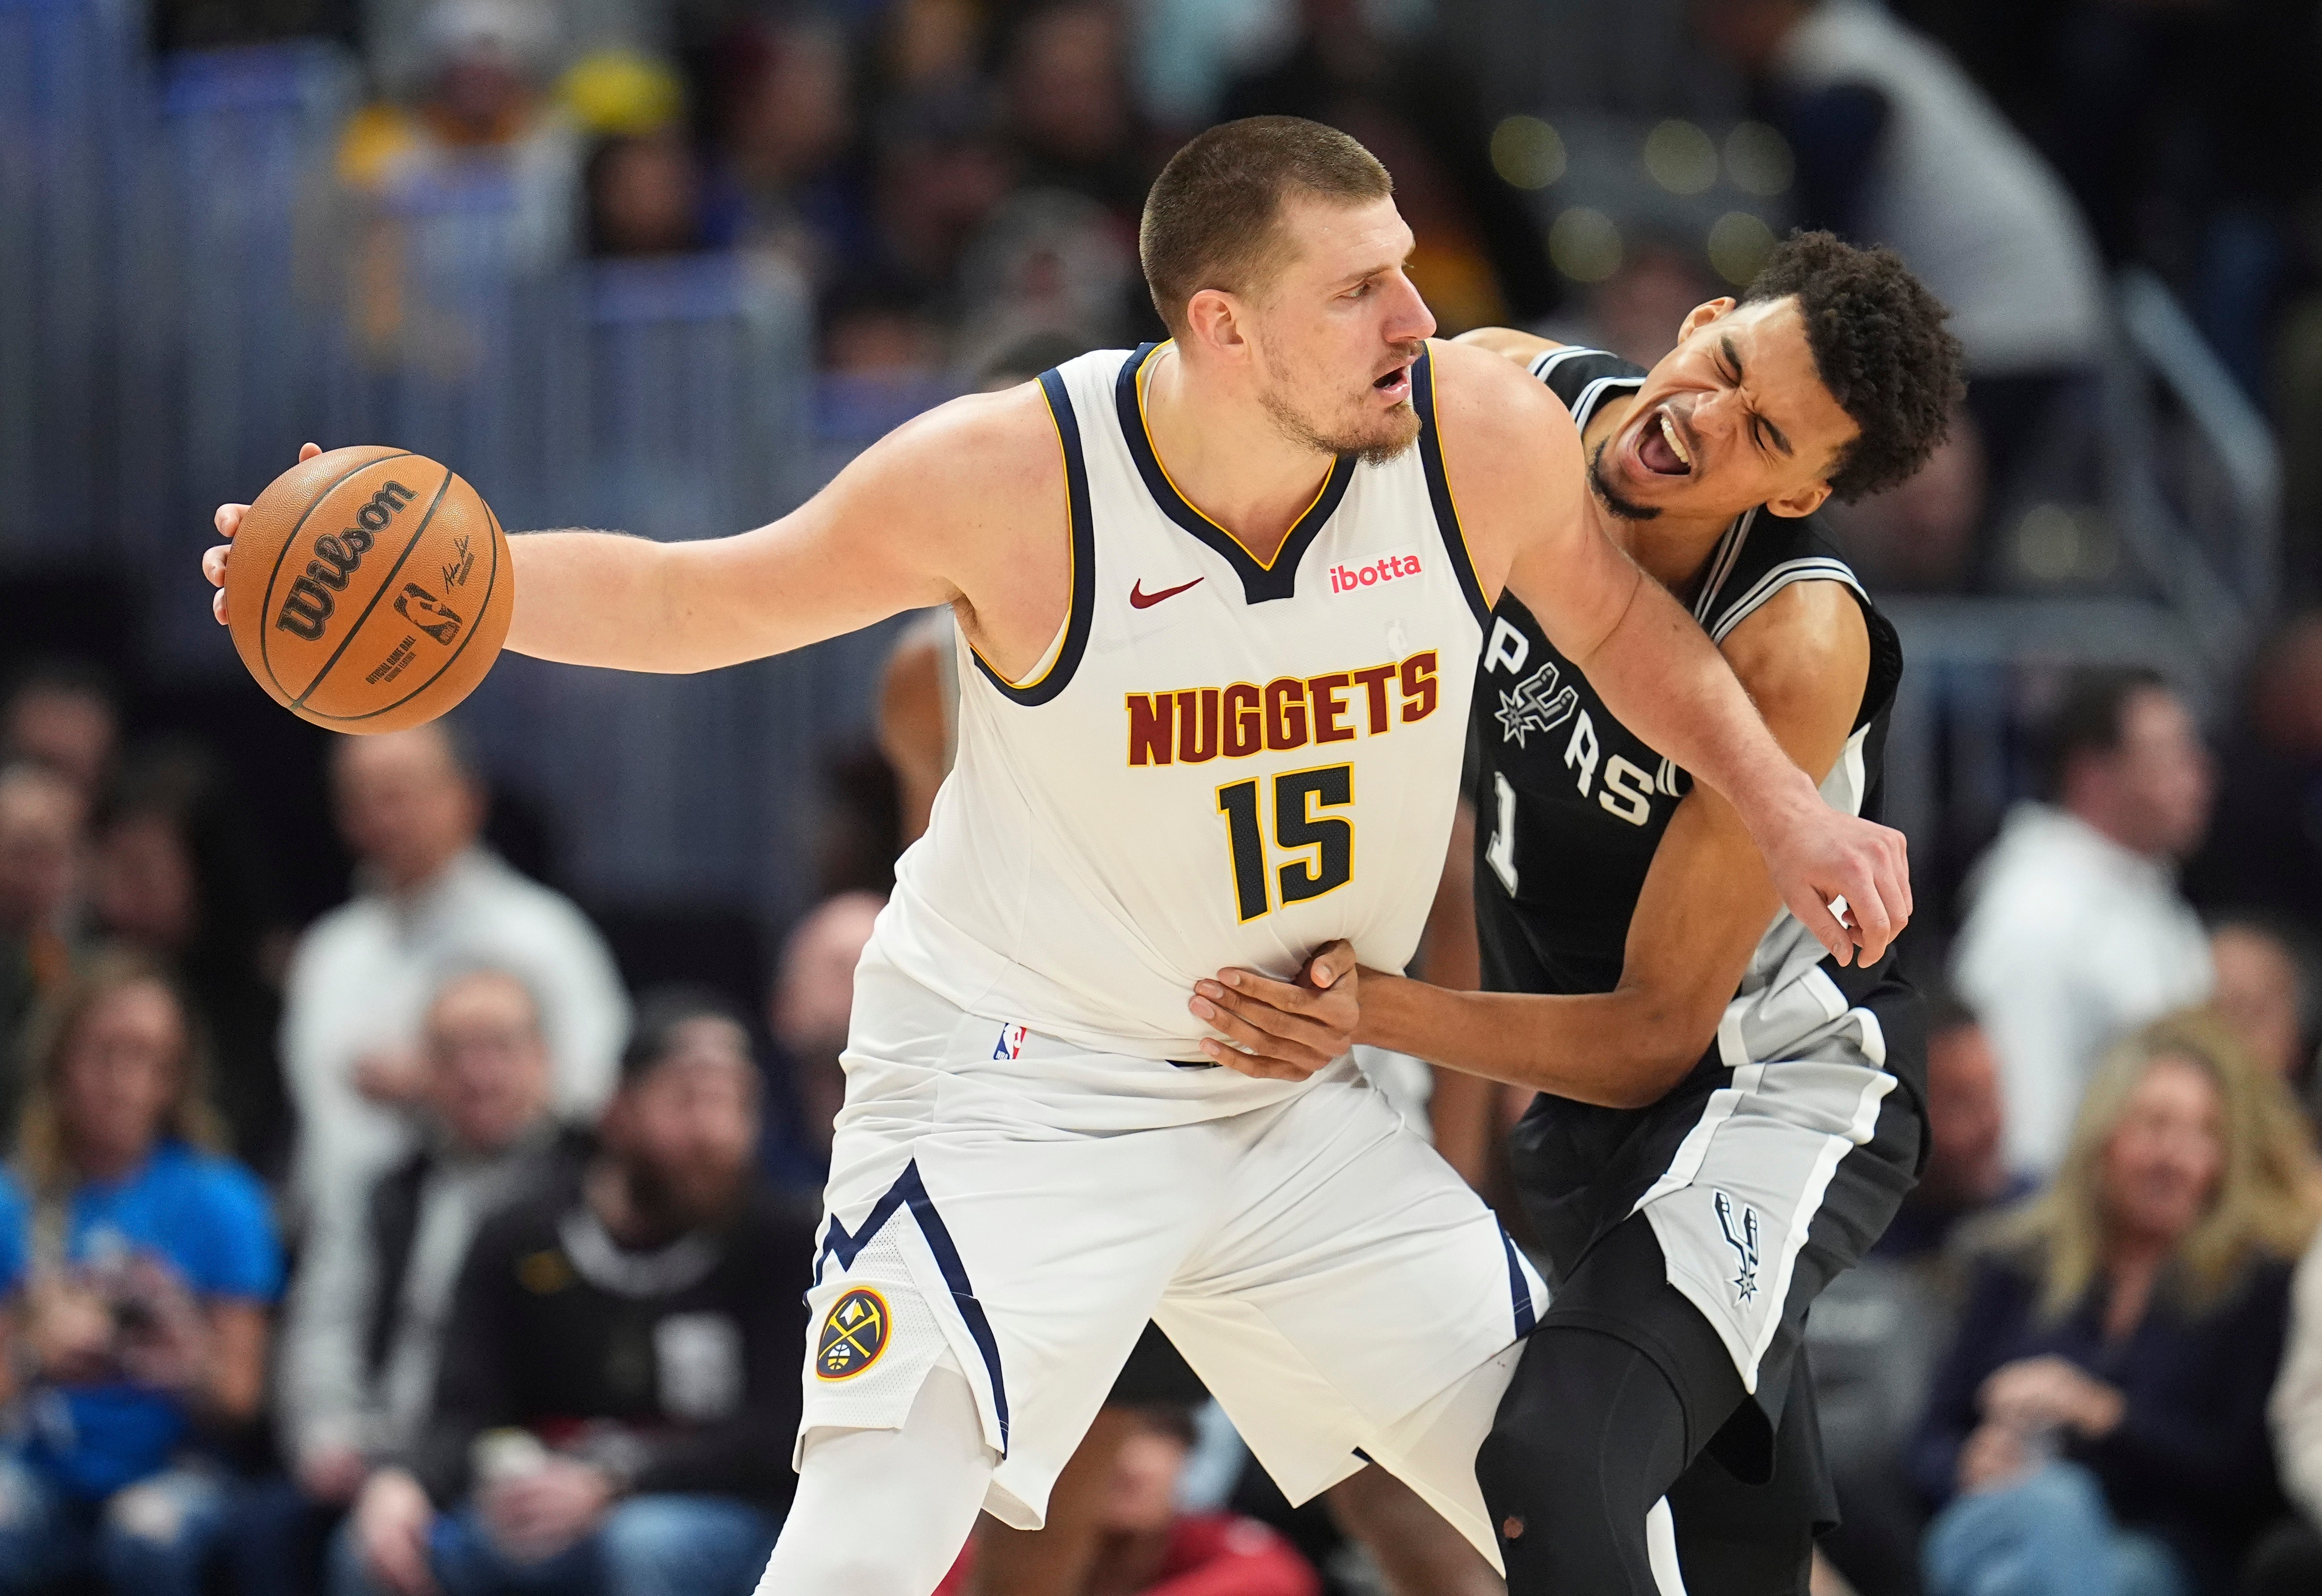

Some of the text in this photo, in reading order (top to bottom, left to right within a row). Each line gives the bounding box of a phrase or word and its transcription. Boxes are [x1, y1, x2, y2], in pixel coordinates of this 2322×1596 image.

[275, 481, 419, 640] Wilson
[1329, 555, 1422, 594] ibotta
[366, 635, 416, 684] OFFICIAL GAME BALL
[398, 651, 417, 669] LEATHER
[1125, 649, 1438, 767] NUGGETS
[1484, 616, 1655, 826] PURS
[1215, 761, 1355, 925] 15
[995, 1050, 1008, 1059] NBA
